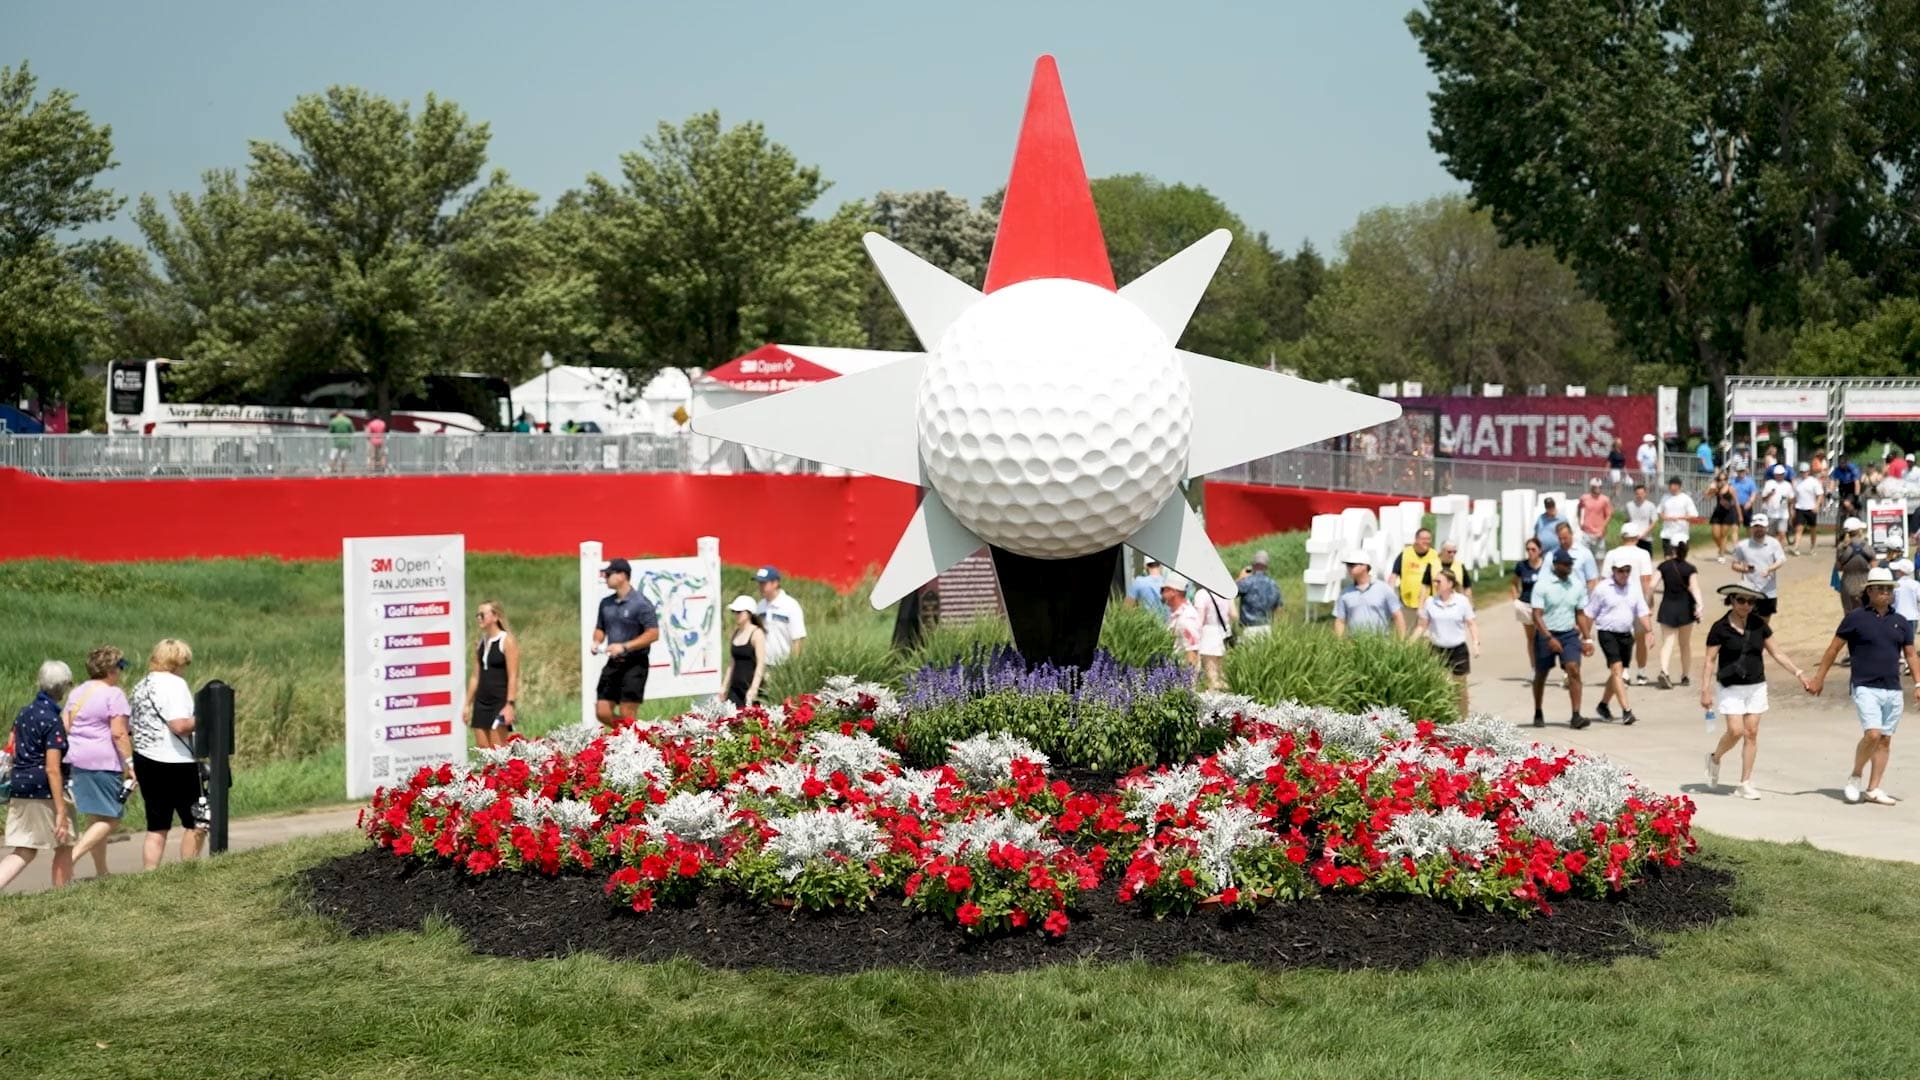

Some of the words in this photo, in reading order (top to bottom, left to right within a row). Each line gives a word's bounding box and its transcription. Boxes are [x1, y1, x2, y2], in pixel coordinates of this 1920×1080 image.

[758, 360, 783, 375] Open
[1439, 414, 1615, 458] MATTERS
[371, 558, 393, 573] 3M
[395, 557, 431, 574] Open
[373, 579, 393, 590] FAN
[395, 576, 446, 589] JOURNEYS
[387, 604, 408, 617] Golf
[408, 603, 445, 616] Fanatics
[373, 638, 380, 648] 2
[388, 635, 424, 647] Foodies
[373, 668, 380, 678] 3
[388, 665, 417, 678] Social
[389, 695, 419, 708] Family
[374, 729, 381, 739] 5
[389, 726, 406, 739] 3M
[406, 725, 441, 737] Science
